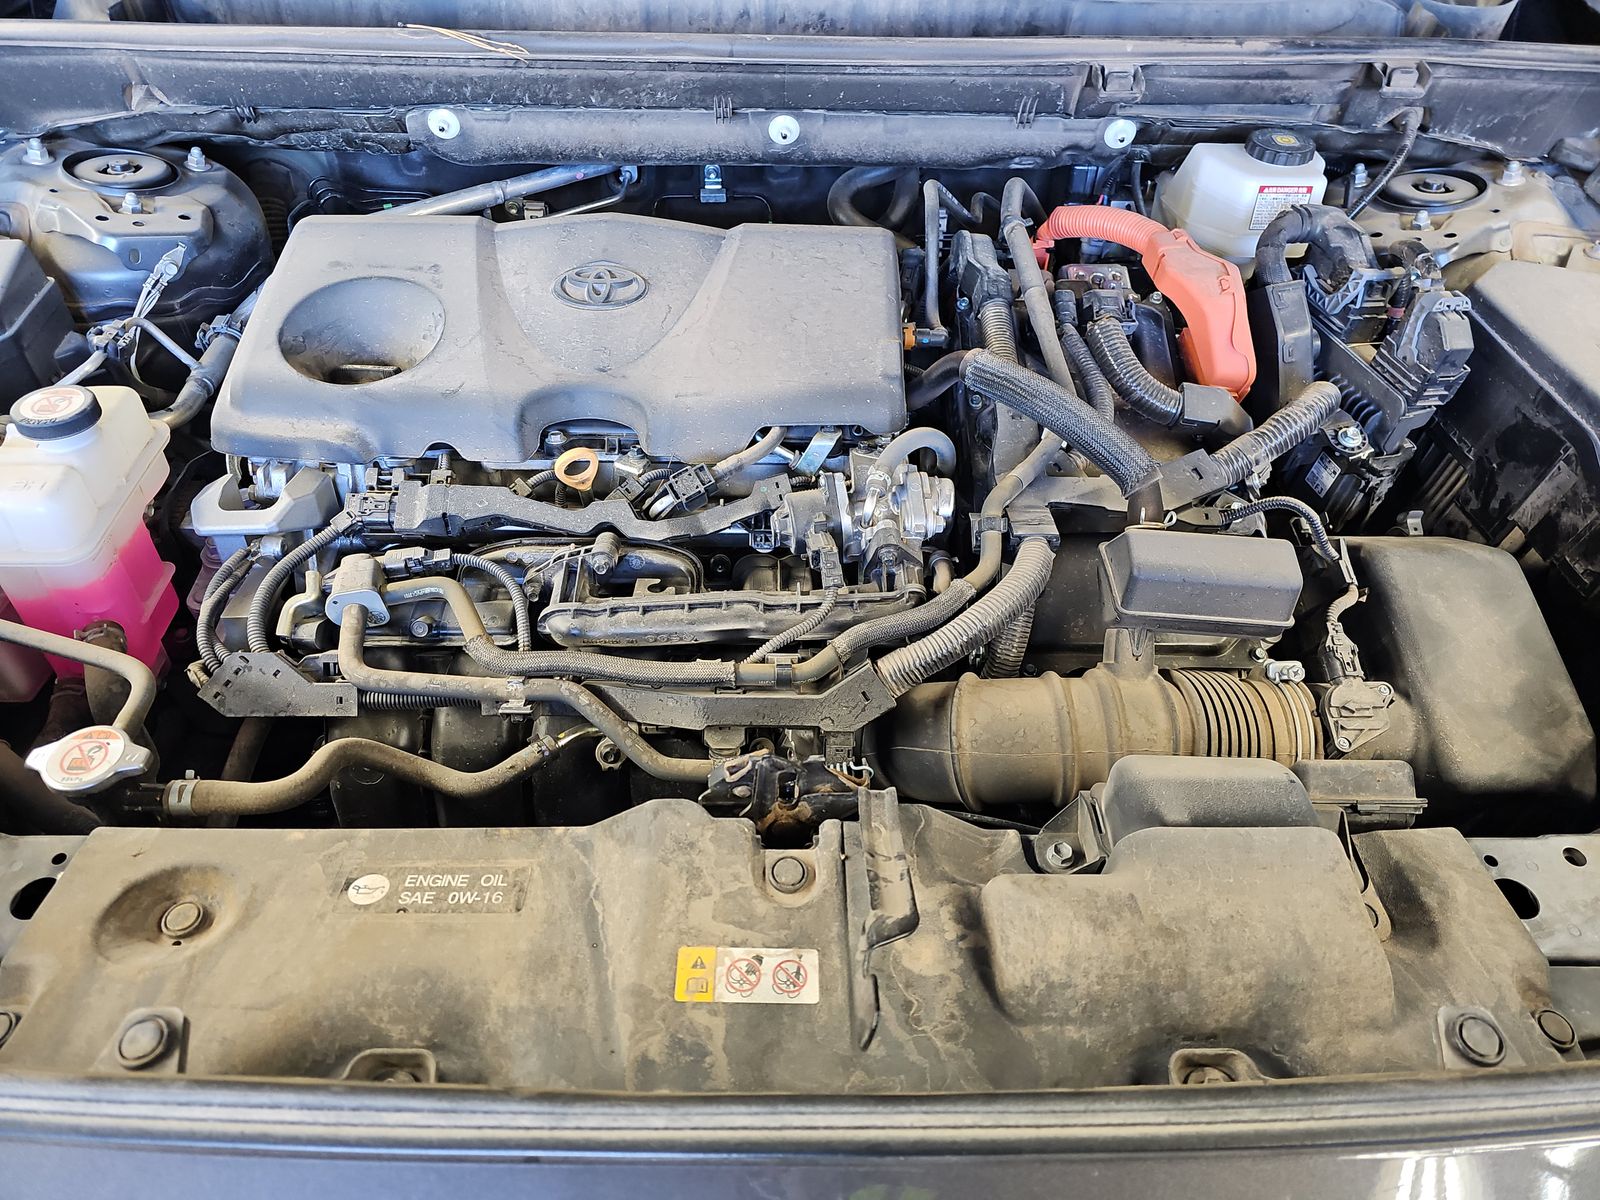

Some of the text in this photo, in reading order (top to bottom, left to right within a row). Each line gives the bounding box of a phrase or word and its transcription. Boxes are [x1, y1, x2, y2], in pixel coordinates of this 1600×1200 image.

[404, 874, 508, 887] ENGINE OIL
[398, 891, 504, 905] SAE 0W-16
